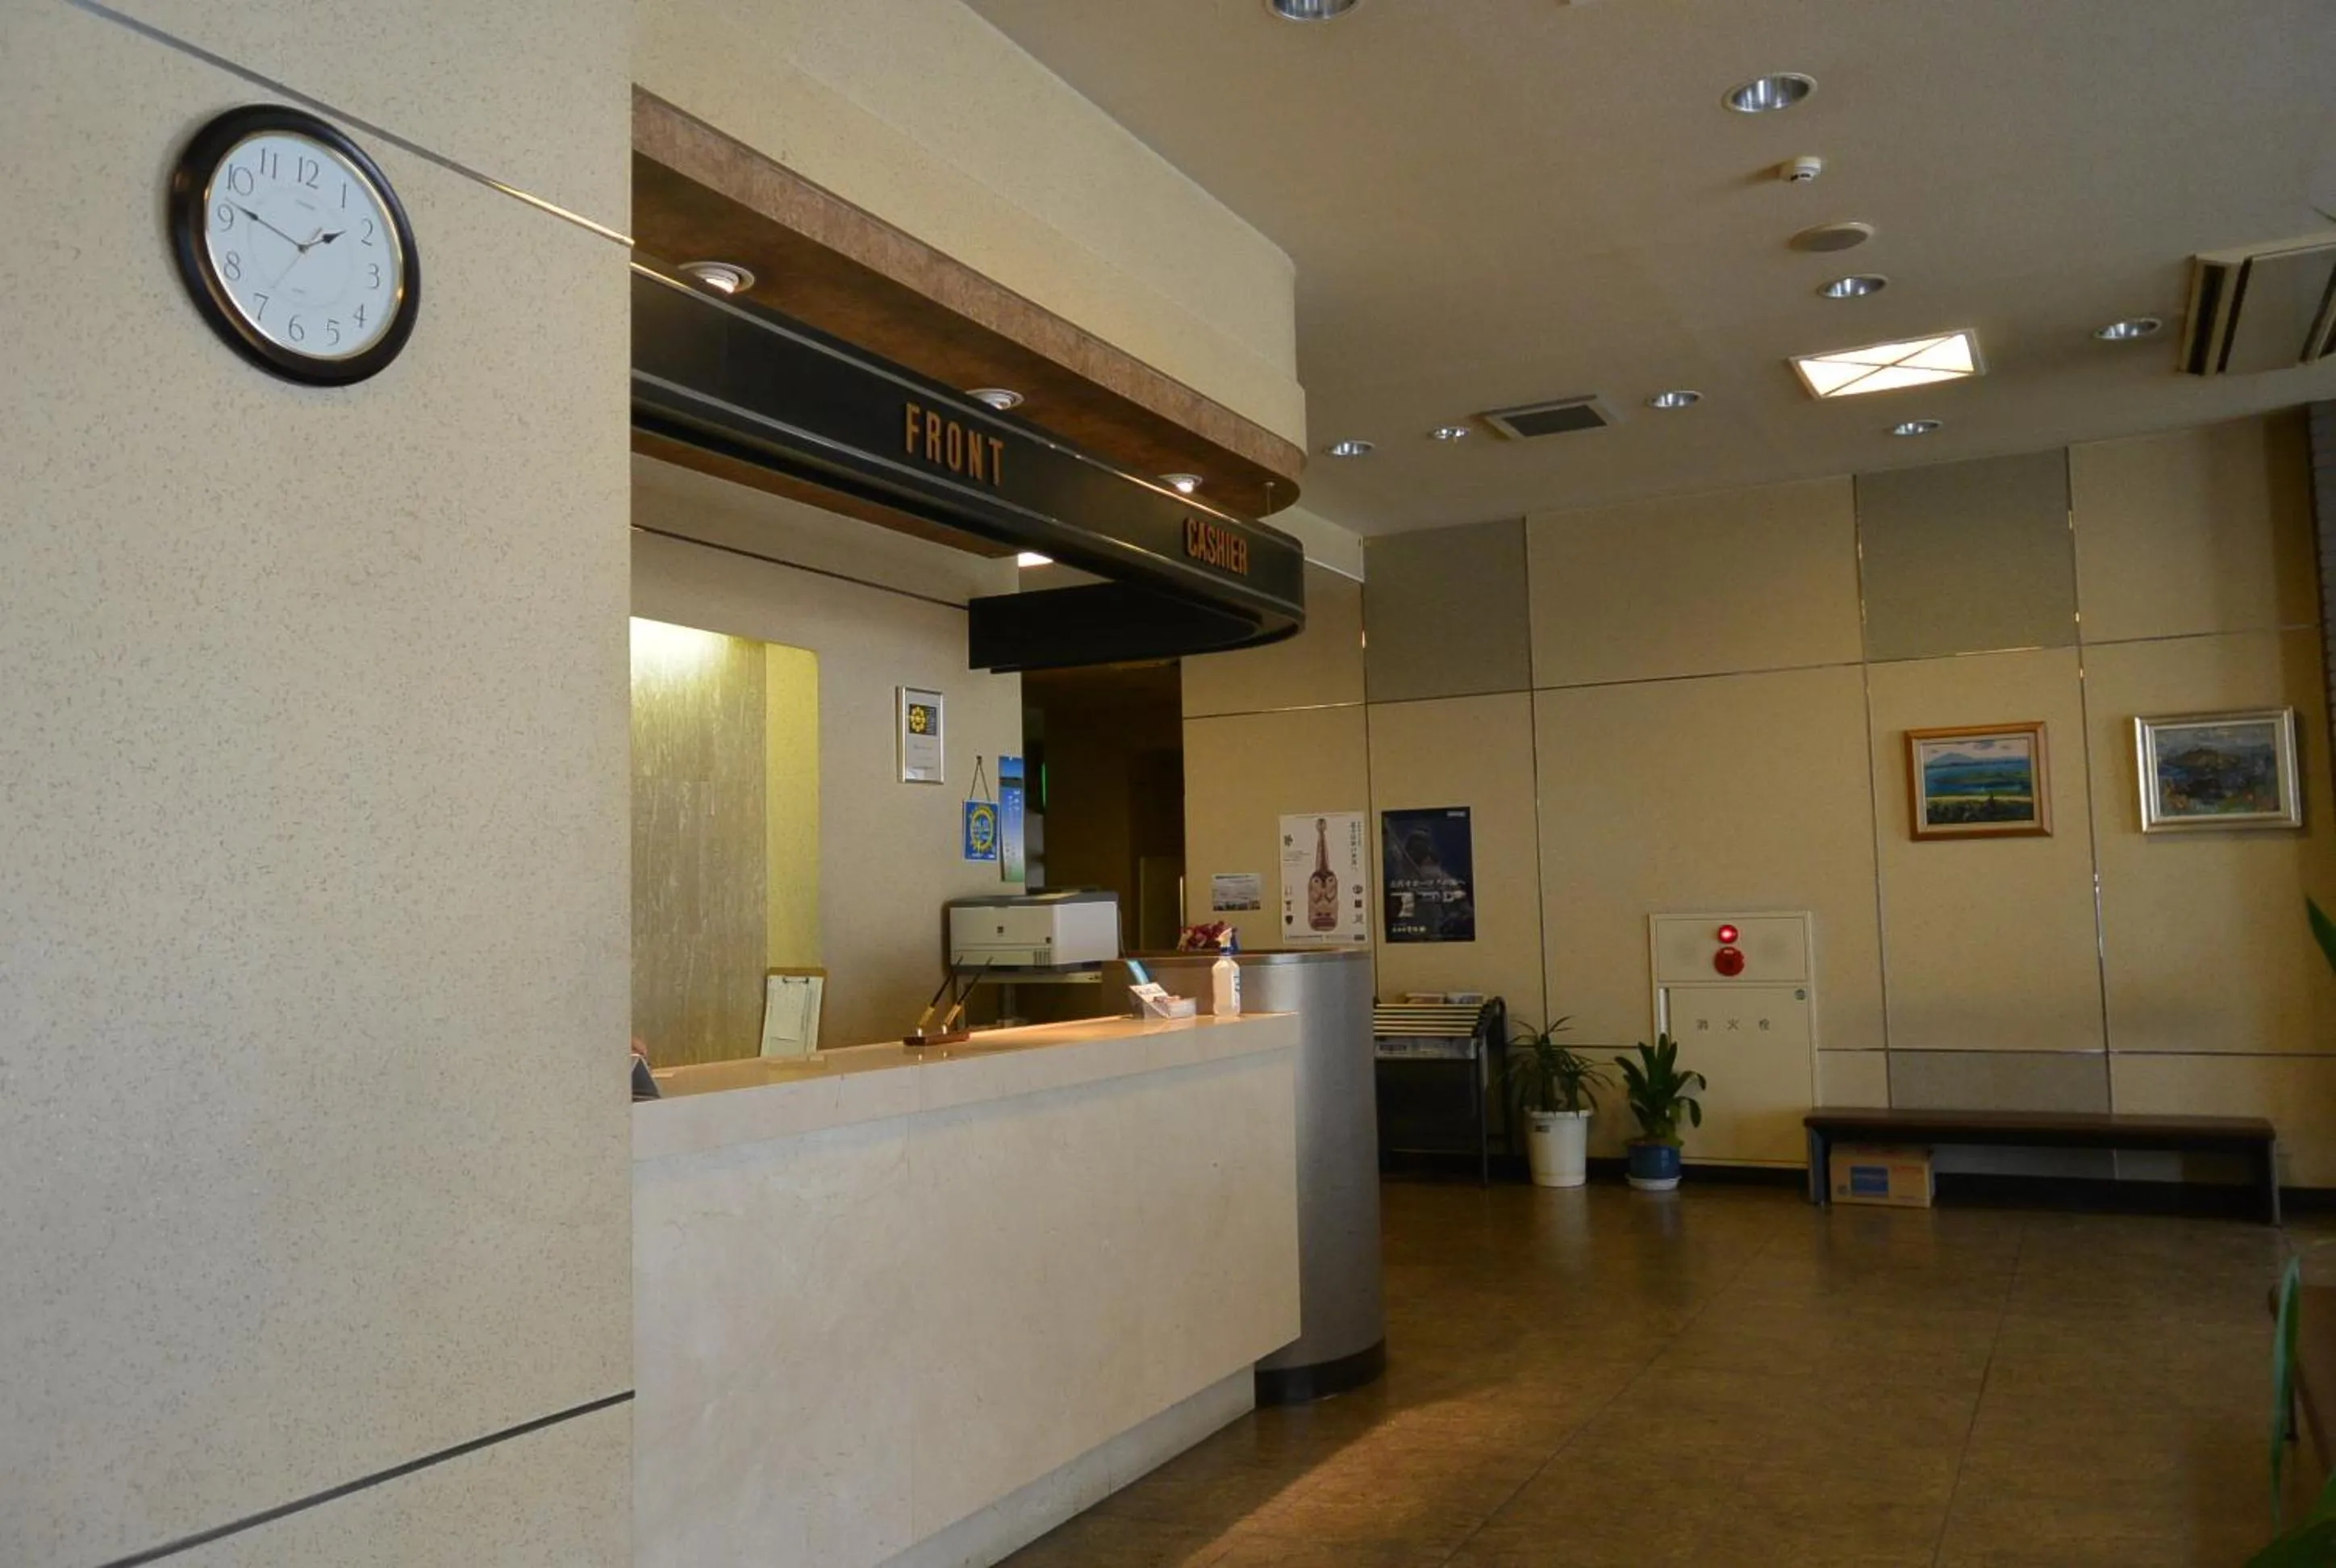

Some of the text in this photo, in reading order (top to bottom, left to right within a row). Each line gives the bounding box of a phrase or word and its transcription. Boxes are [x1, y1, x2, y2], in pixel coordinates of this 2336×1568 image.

[260, 148, 278, 180] 11
[297, 156, 319, 189] 12
[227, 164, 254, 196] 10
[341, 181, 348, 209] 1
[216, 202, 235, 232] 9
[361, 217, 373, 246] 2
[223, 250, 241, 281] 8
[367, 262, 381, 290] 3
[252, 292, 270, 321] 7
[352, 303, 369, 328] 4
[288, 314, 305, 342] 6
[326, 319, 340, 346] 5
[905, 402, 1004, 486] FRONT
[1183, 516, 1249, 576] CASHIER
